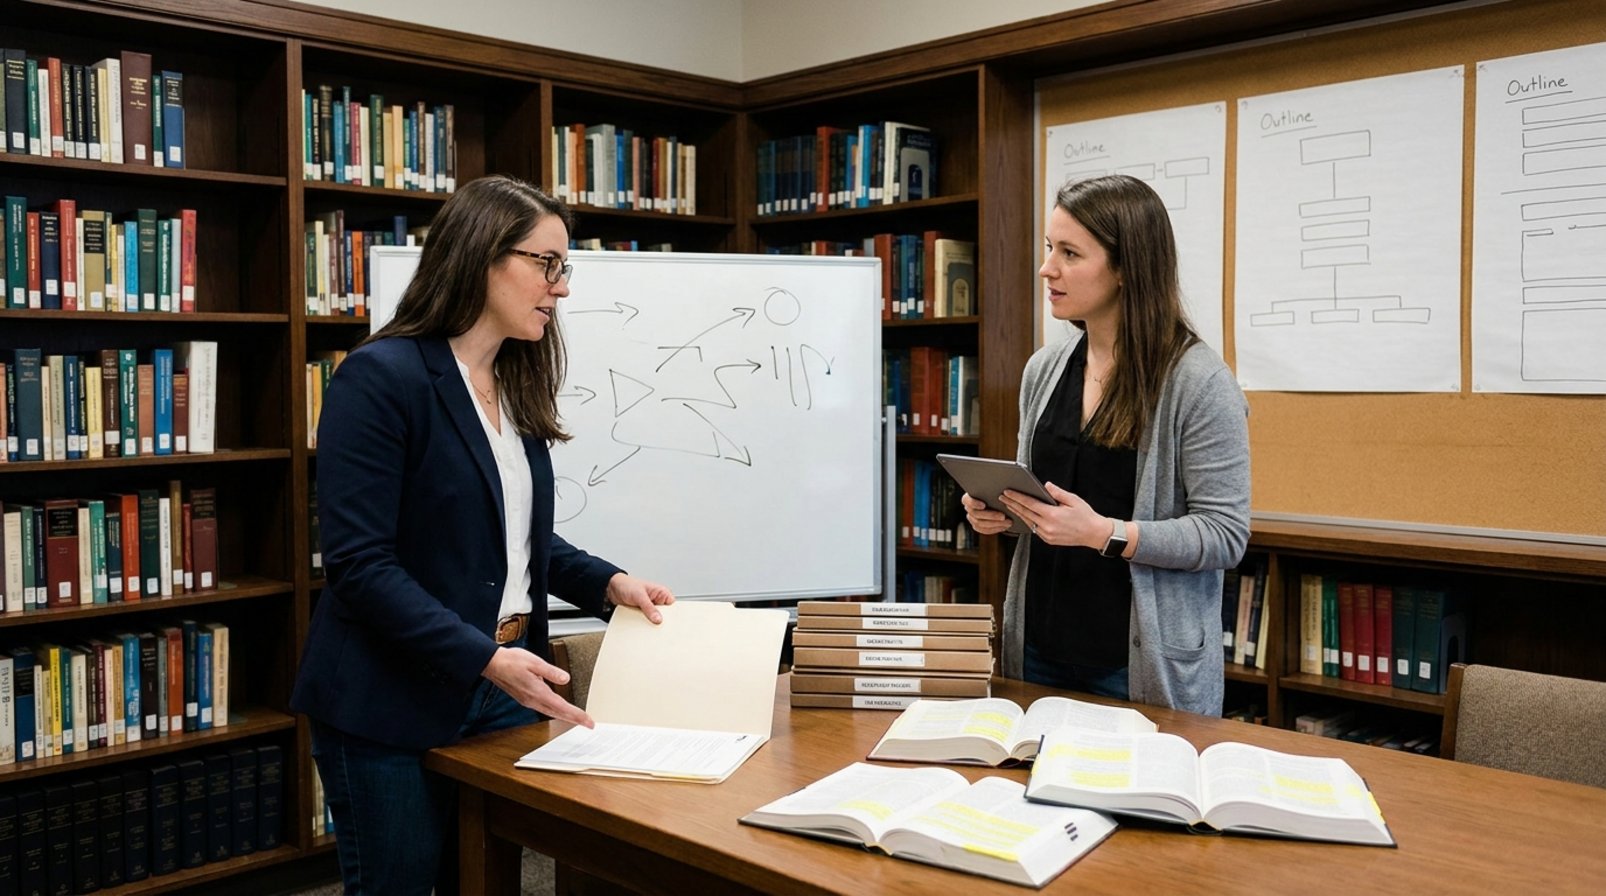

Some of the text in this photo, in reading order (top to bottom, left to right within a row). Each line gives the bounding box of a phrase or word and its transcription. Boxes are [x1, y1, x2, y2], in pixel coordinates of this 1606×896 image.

[1507, 75, 1569, 96] Outline
[1260, 109, 1315, 130] Outline
[1063, 140, 1106, 159] Outline
